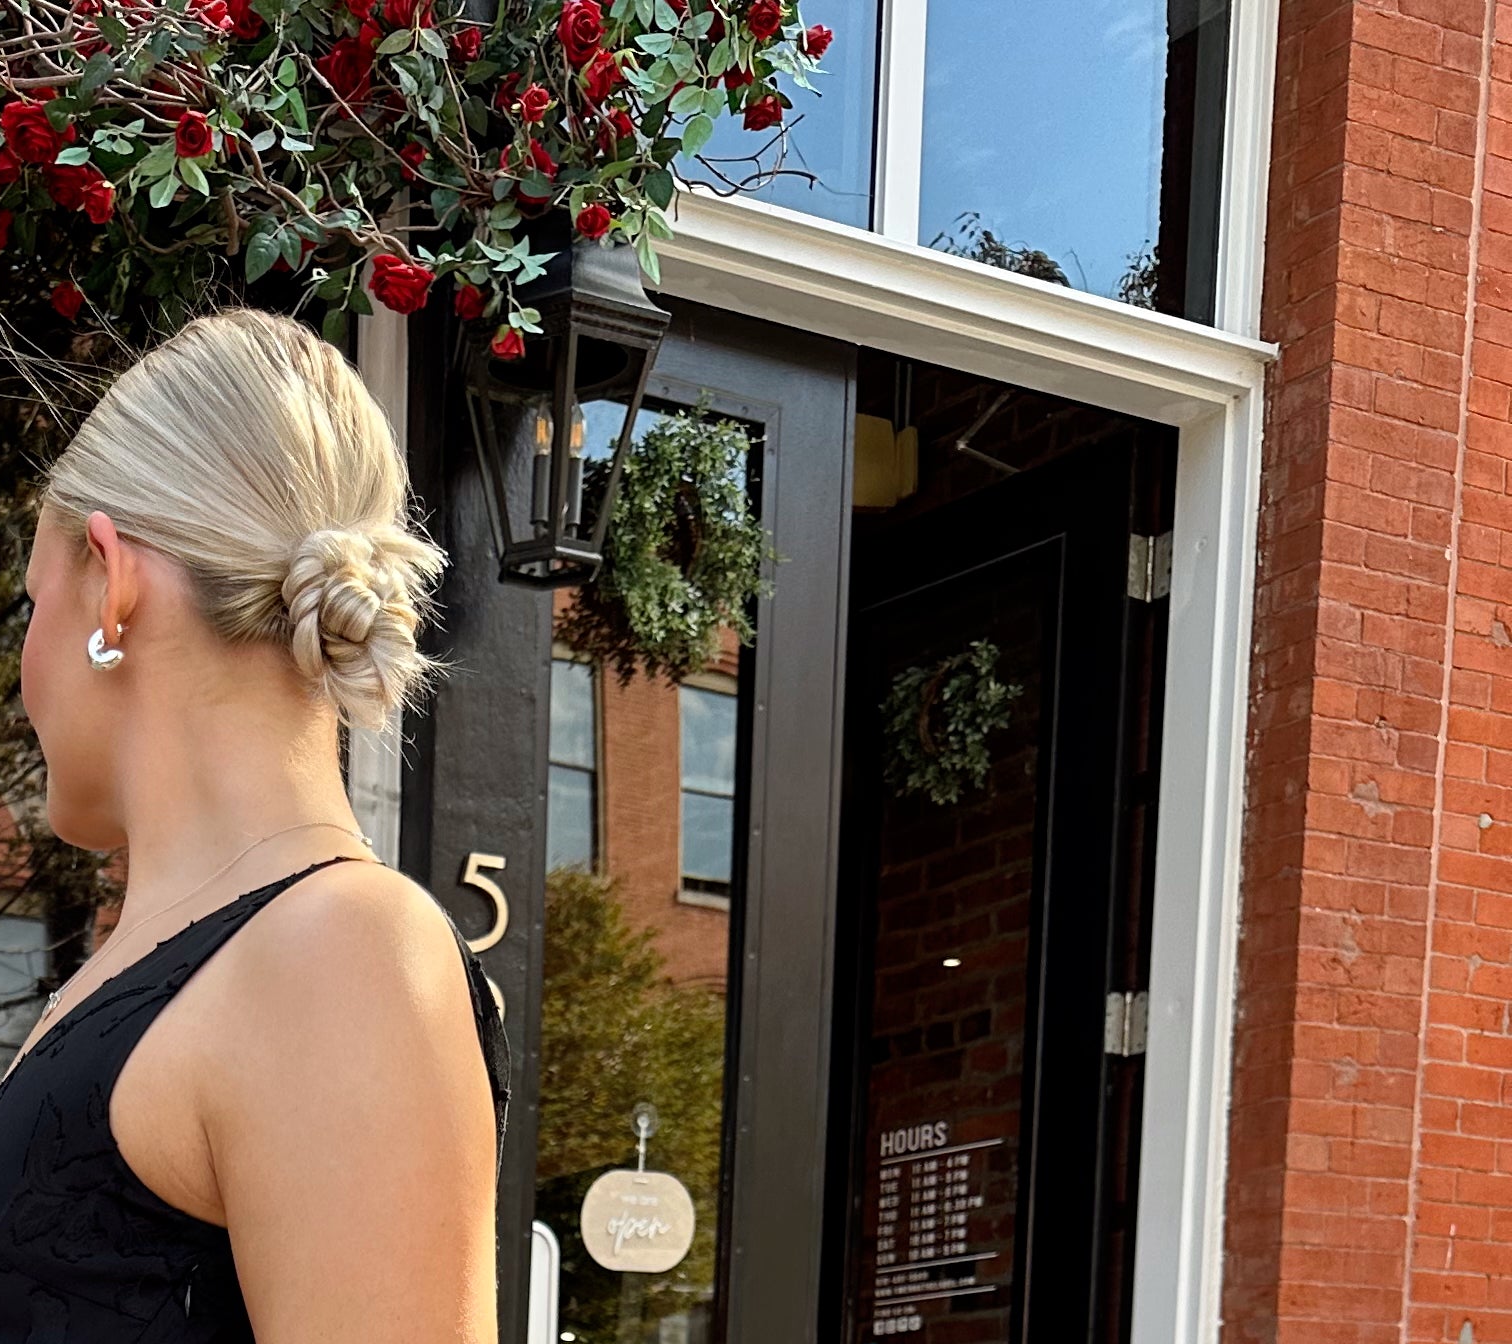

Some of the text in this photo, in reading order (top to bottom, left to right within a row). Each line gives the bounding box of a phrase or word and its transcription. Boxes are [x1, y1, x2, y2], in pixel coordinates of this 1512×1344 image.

[463, 852, 509, 954] 5
[880, 1120, 948, 1157] HOURS
[923, 1160, 938, 1172] AM
[954, 1154, 971, 1166] PM
[923, 1174, 937, 1186] AM
[953, 1169, 969, 1181] PM
[922, 1189, 936, 1200] AM
[952, 1184, 968, 1195] PM
[922, 1204, 936, 1215] AM
[967, 1196, 984, 1208] PM
[921, 1218, 935, 1229] AM
[951, 1213, 967, 1224] PM
[606, 1210, 672, 1256] open
[921, 1232, 935, 1244] AM
[951, 1227, 967, 1239] PM
[921, 1247, 935, 1258] AM
[951, 1242, 966, 1253] PM
